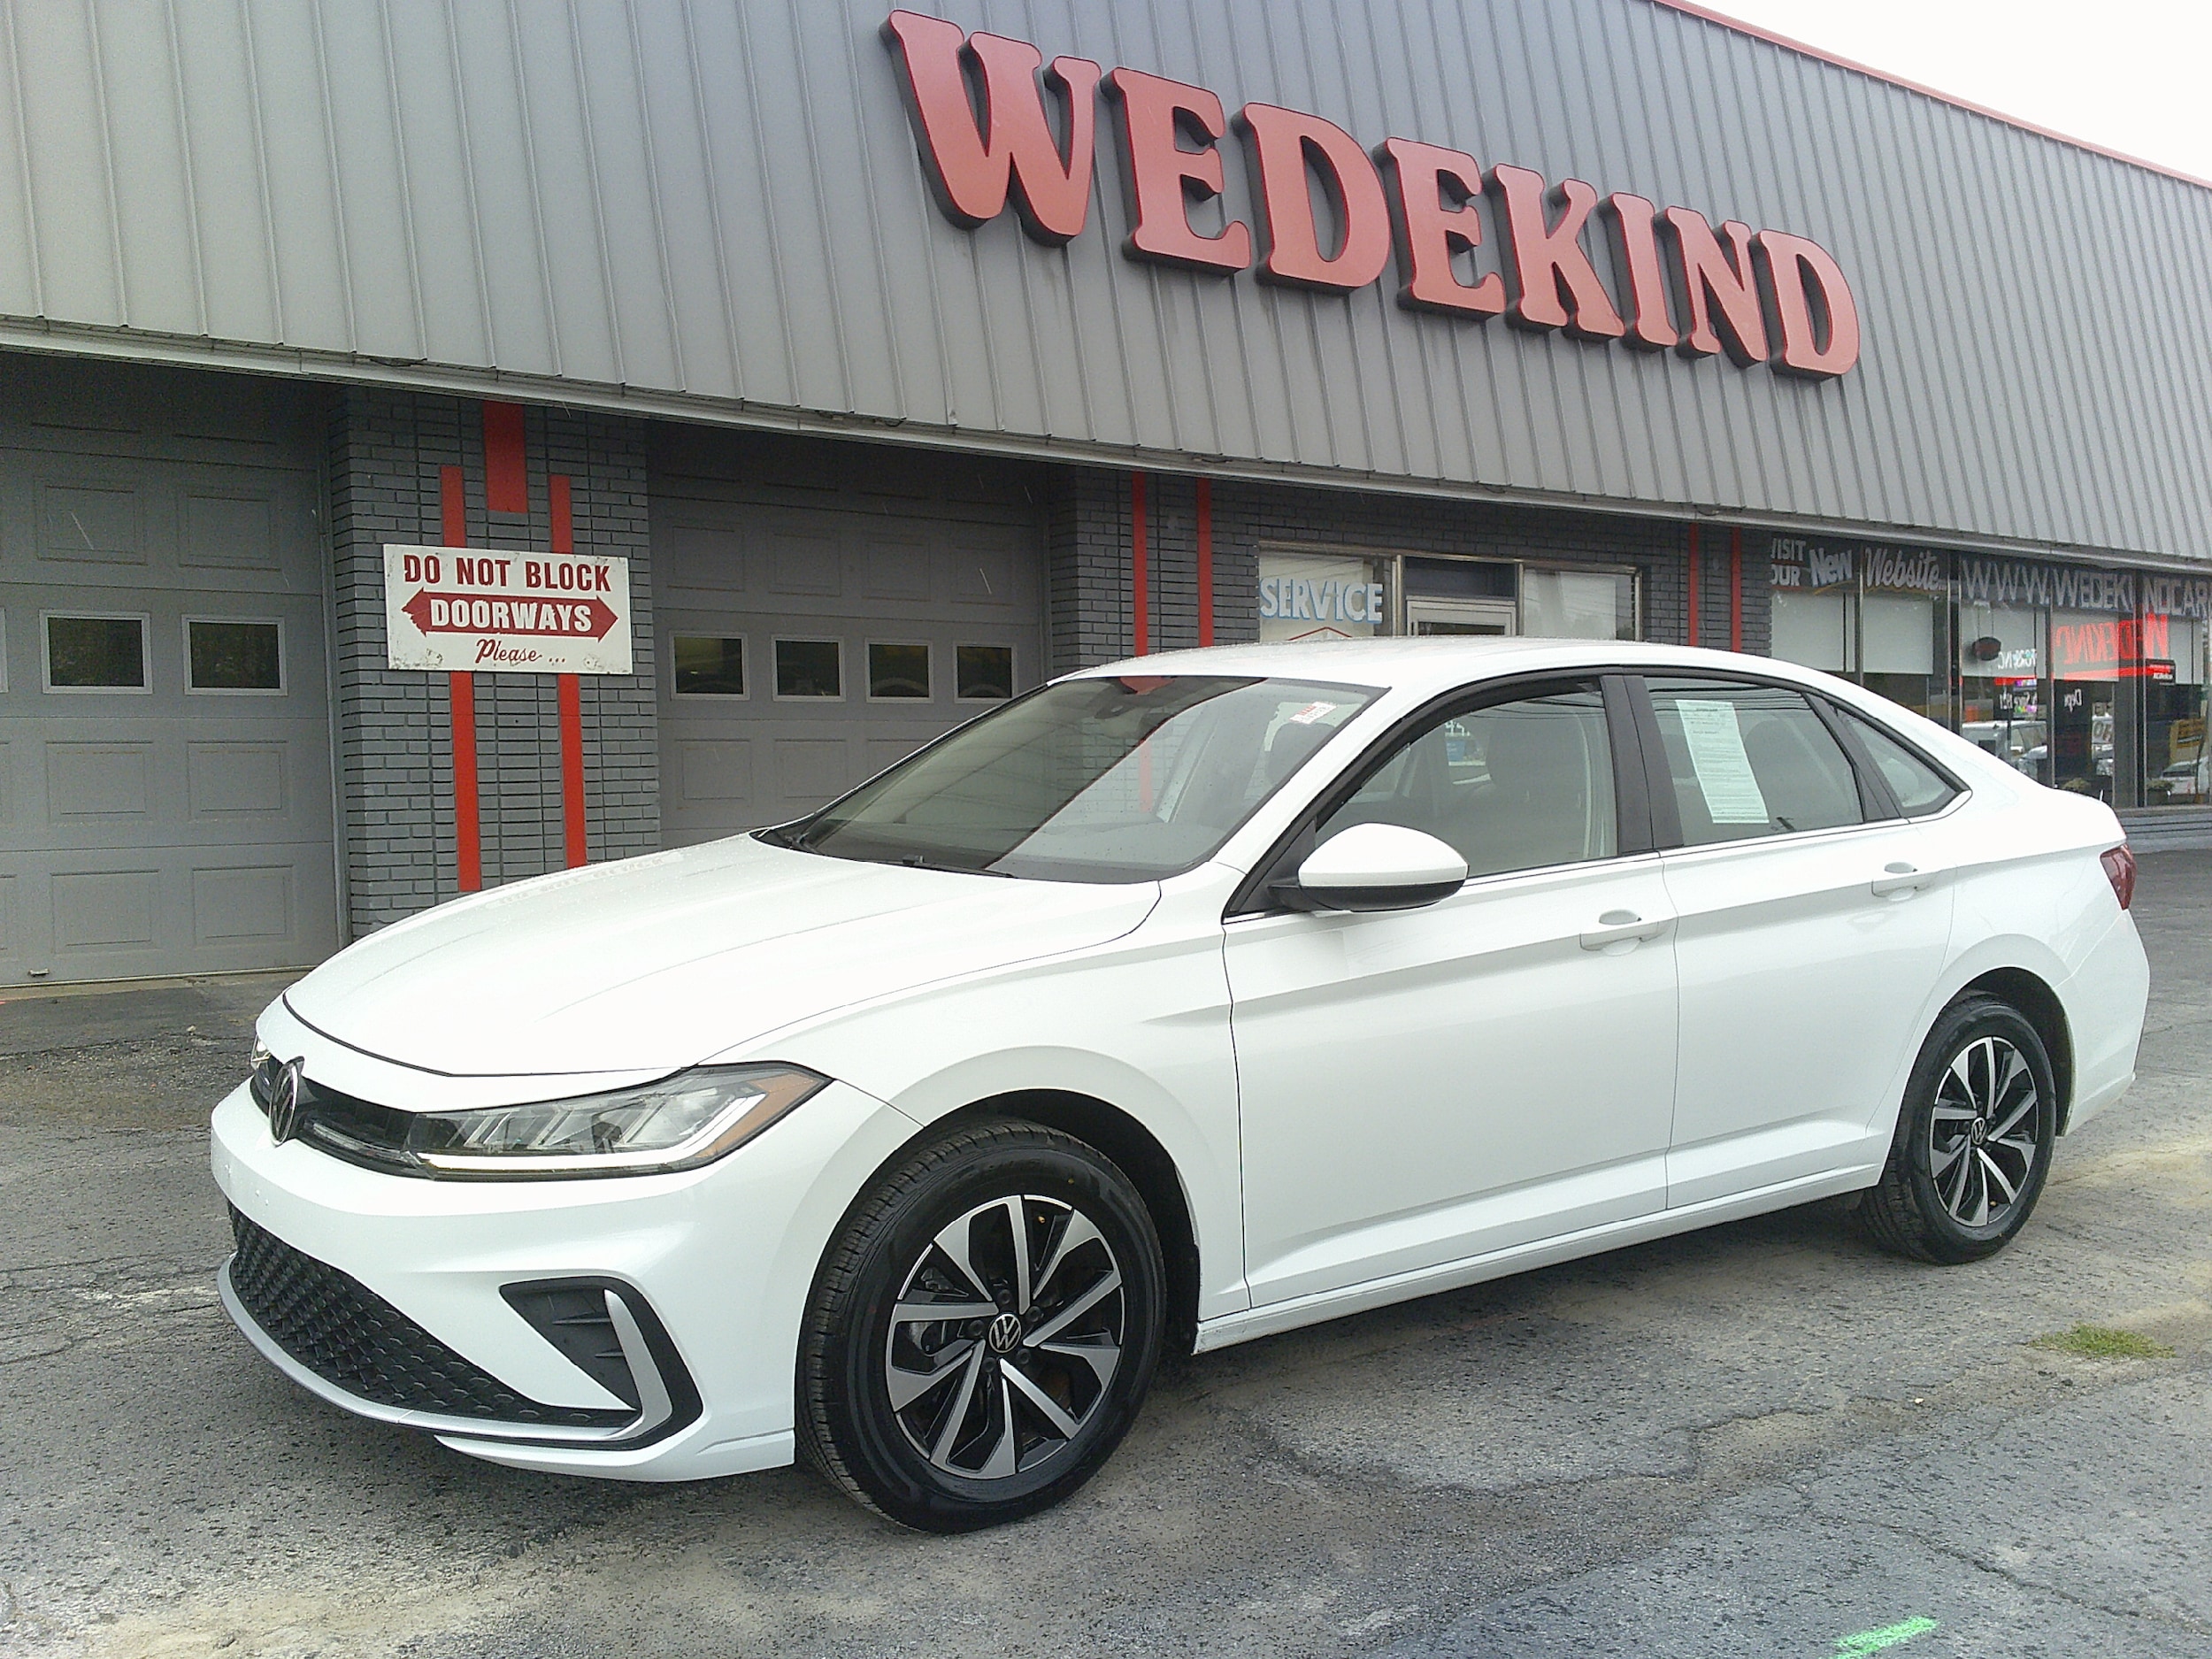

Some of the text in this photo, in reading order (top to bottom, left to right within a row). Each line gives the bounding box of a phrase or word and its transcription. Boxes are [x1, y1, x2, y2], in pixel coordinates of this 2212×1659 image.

[885, 11, 1860, 379] WEDEKIND
[403, 555, 611, 592] DO NOT BLOCK
[430, 598, 593, 632] DOORWAYS
[1259, 578, 1383, 624] SERVICE
[474, 638, 542, 664] Please
